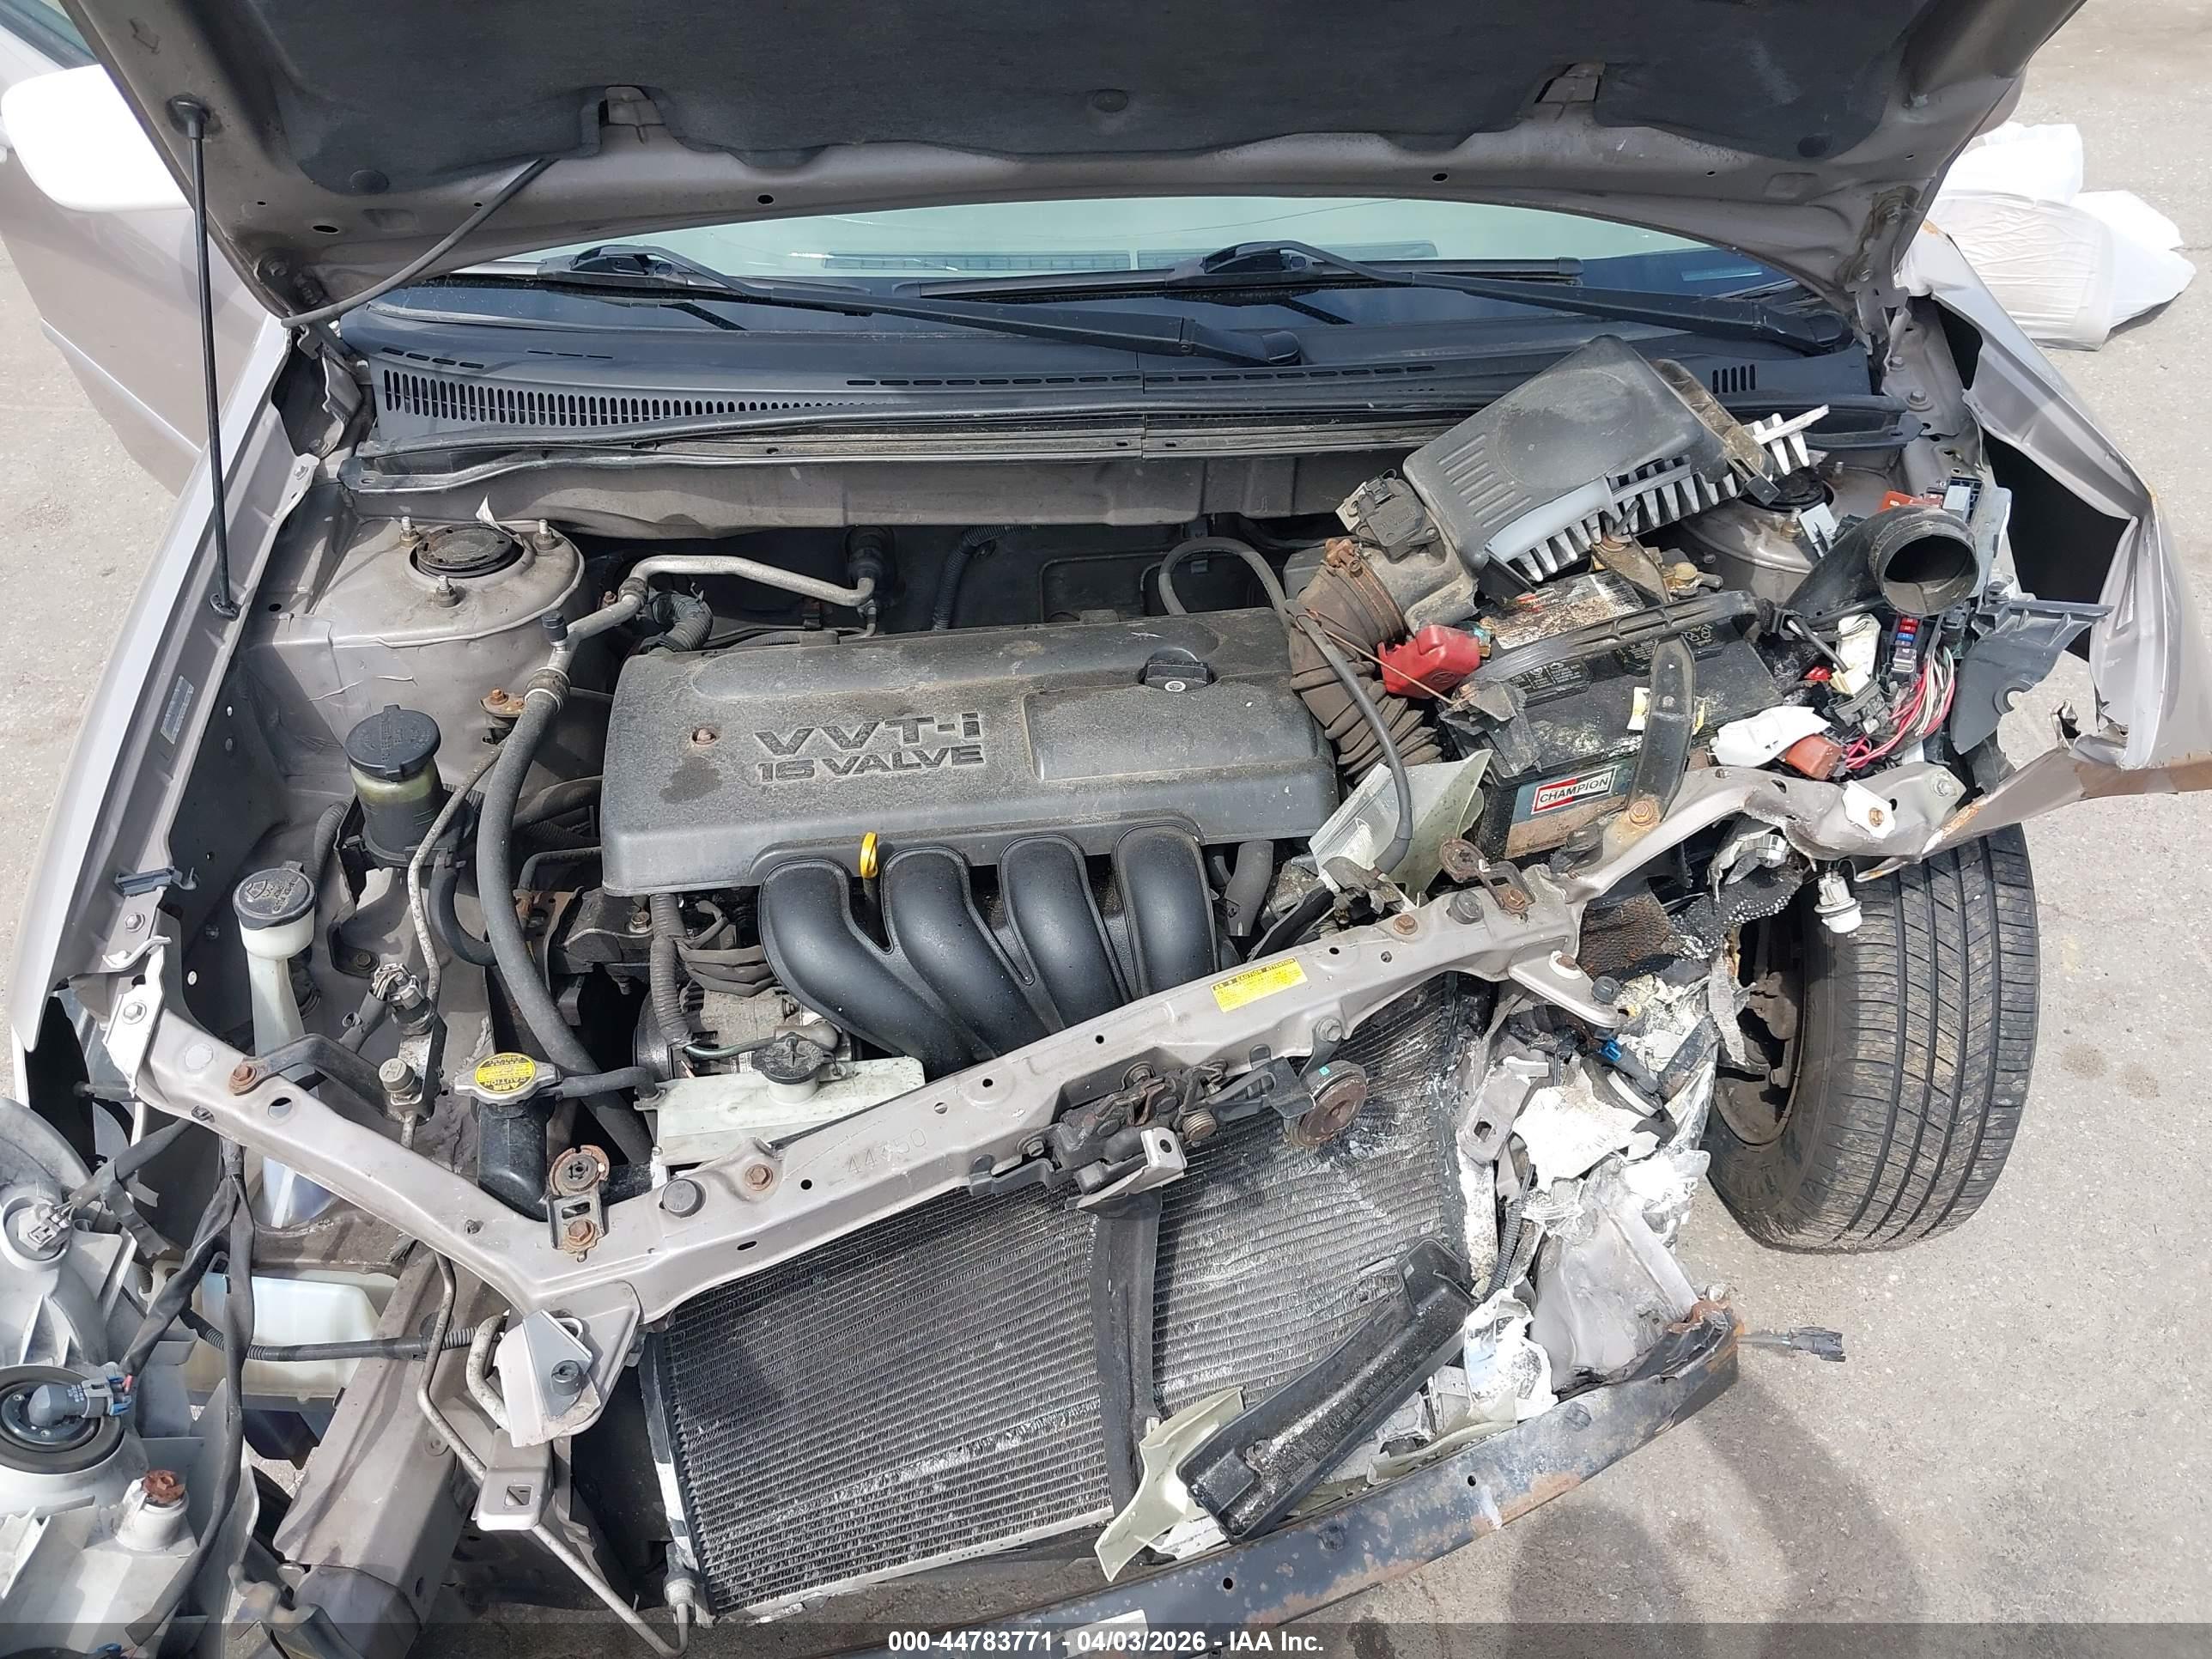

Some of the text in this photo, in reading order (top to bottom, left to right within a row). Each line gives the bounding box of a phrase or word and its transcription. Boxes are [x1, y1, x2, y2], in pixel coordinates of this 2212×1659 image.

[755, 712, 981, 756] VVT-i
[757, 744, 984, 782] 16 VALVE
[1540, 776, 1609, 804] CHAMPION
[484, 1077, 526, 1087] CAUTION
